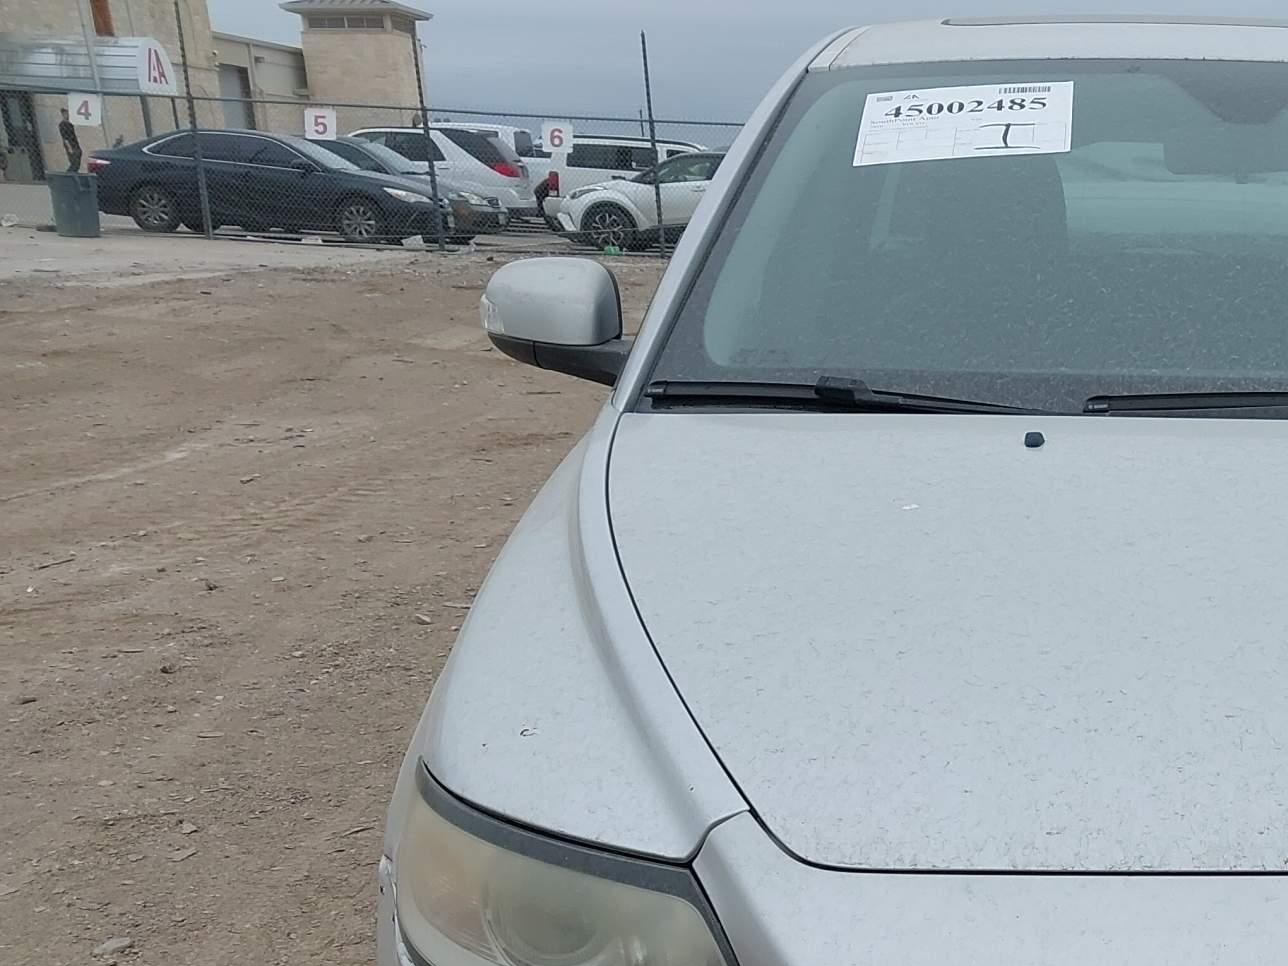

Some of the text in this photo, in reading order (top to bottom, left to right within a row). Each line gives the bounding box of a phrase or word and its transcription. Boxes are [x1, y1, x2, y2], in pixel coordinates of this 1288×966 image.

[76, 100, 92, 121] 4
[884, 97, 1048, 119] 45002485
[313, 114, 329, 136] 5
[549, 127, 565, 148] 6
